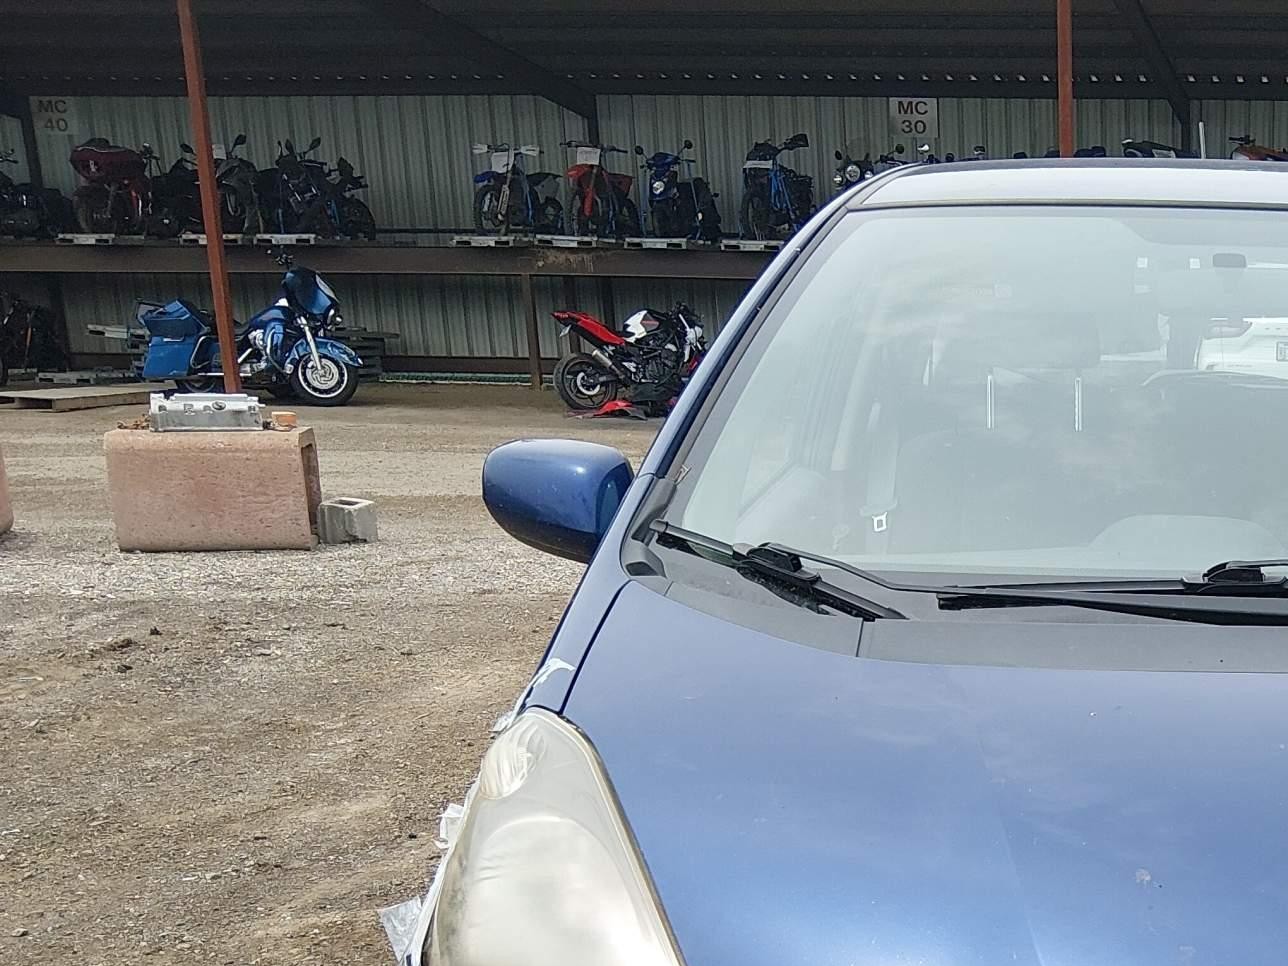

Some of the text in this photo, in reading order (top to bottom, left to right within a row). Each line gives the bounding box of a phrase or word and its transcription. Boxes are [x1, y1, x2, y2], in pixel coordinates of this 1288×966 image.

[38, 100, 67, 113] MC
[897, 100, 929, 115] MC
[44, 118, 68, 132] 40
[900, 119, 927, 134] 30
